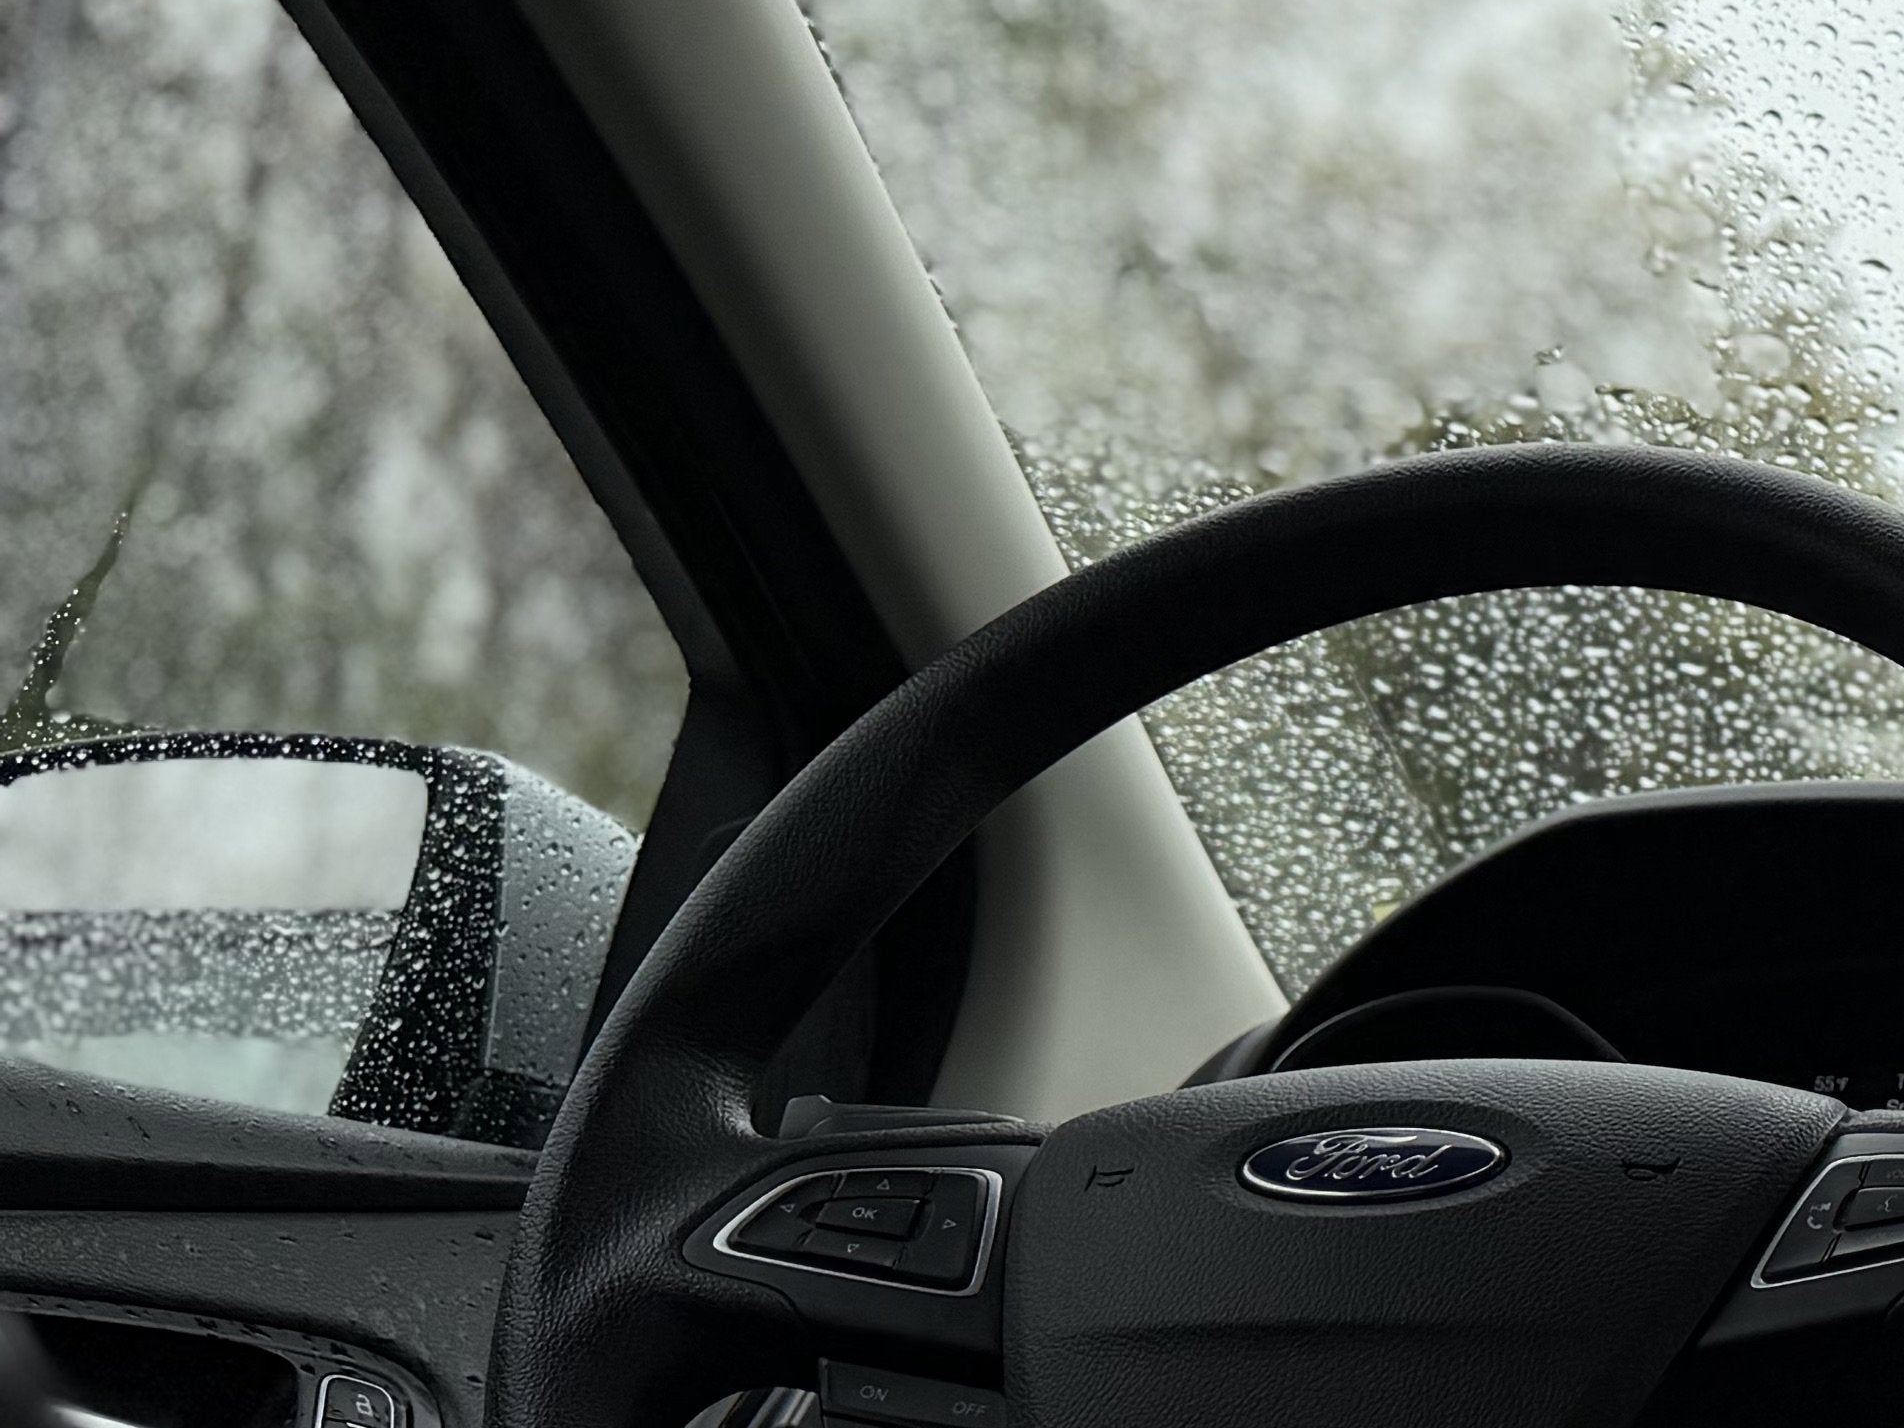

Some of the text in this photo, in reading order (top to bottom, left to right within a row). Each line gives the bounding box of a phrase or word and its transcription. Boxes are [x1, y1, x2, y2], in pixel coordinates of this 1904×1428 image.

[1285, 1134, 1453, 1182] Ford
[851, 1206, 879, 1220] OK
[859, 1384, 889, 1401] ON
[952, 1401, 987, 1417] OFF
